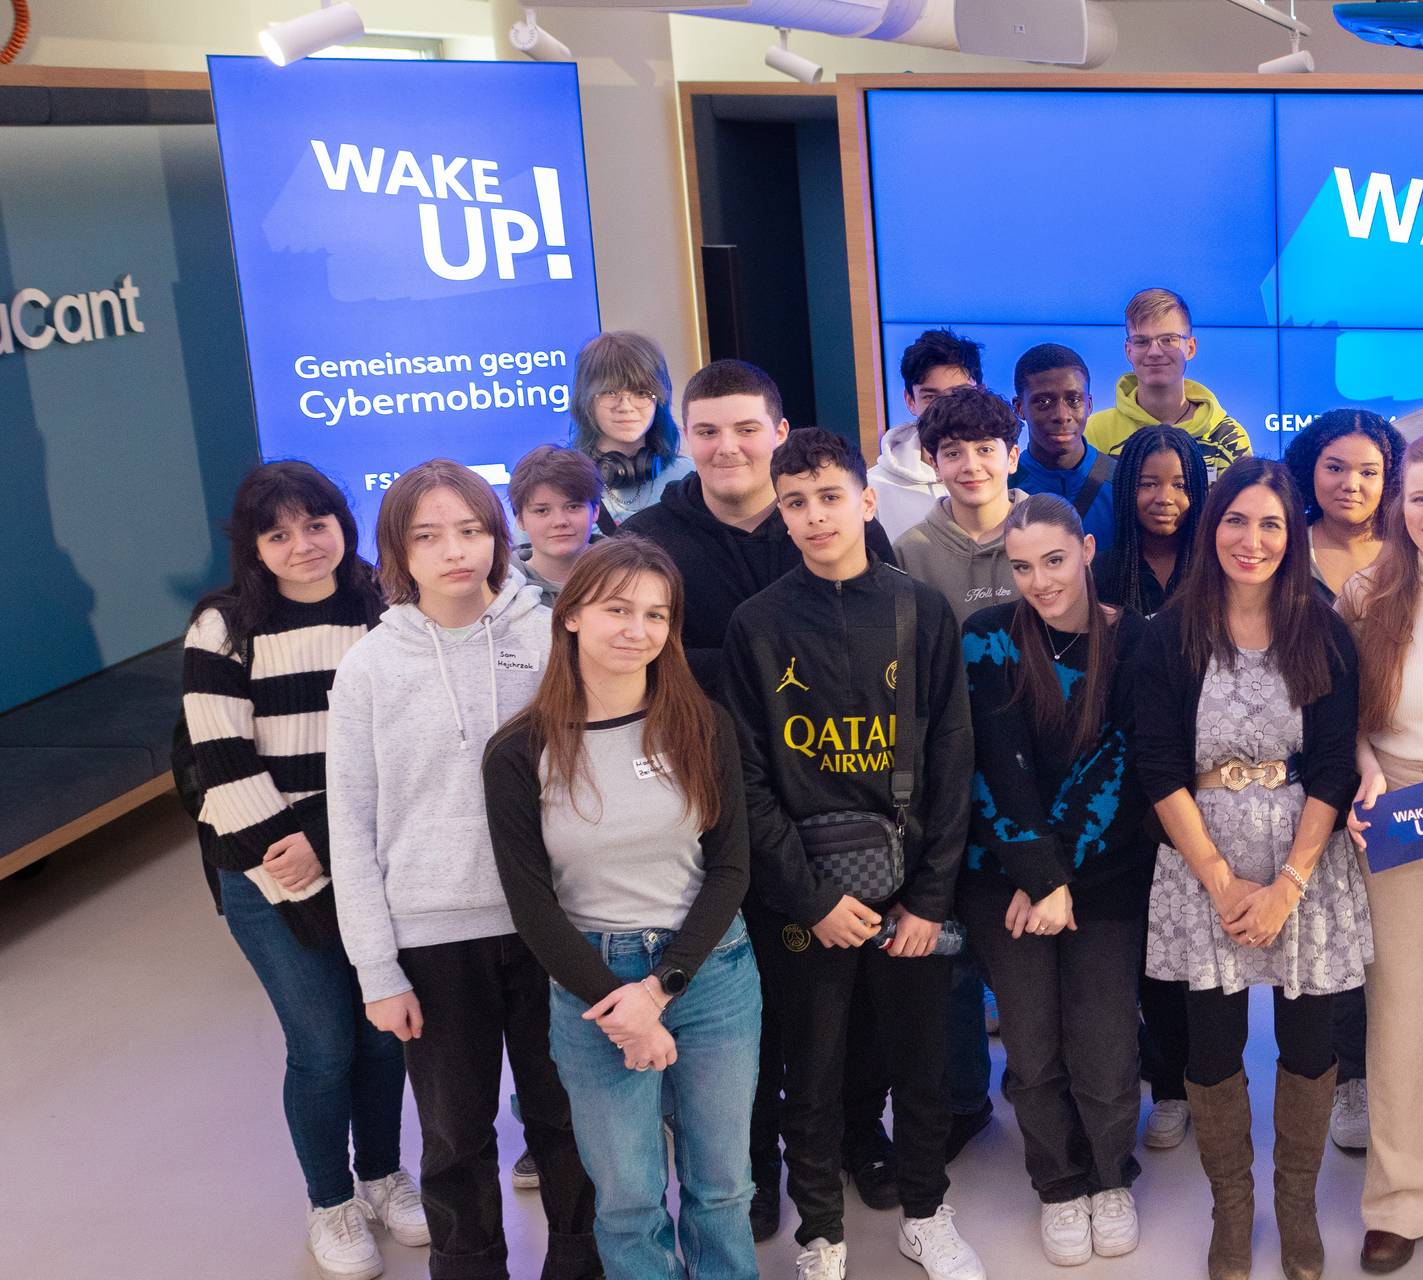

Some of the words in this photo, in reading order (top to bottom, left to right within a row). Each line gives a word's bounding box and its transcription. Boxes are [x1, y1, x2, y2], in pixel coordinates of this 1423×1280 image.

[310, 139, 503, 203] WAKE
[418, 166, 573, 281] UP!
[294, 352, 472, 379] Gemeinsam
[479, 350, 566, 377] gegen
[300, 379, 569, 426] Cybermobbing
[364, 472, 401, 491] FS
[784, 714, 896, 758] QATA
